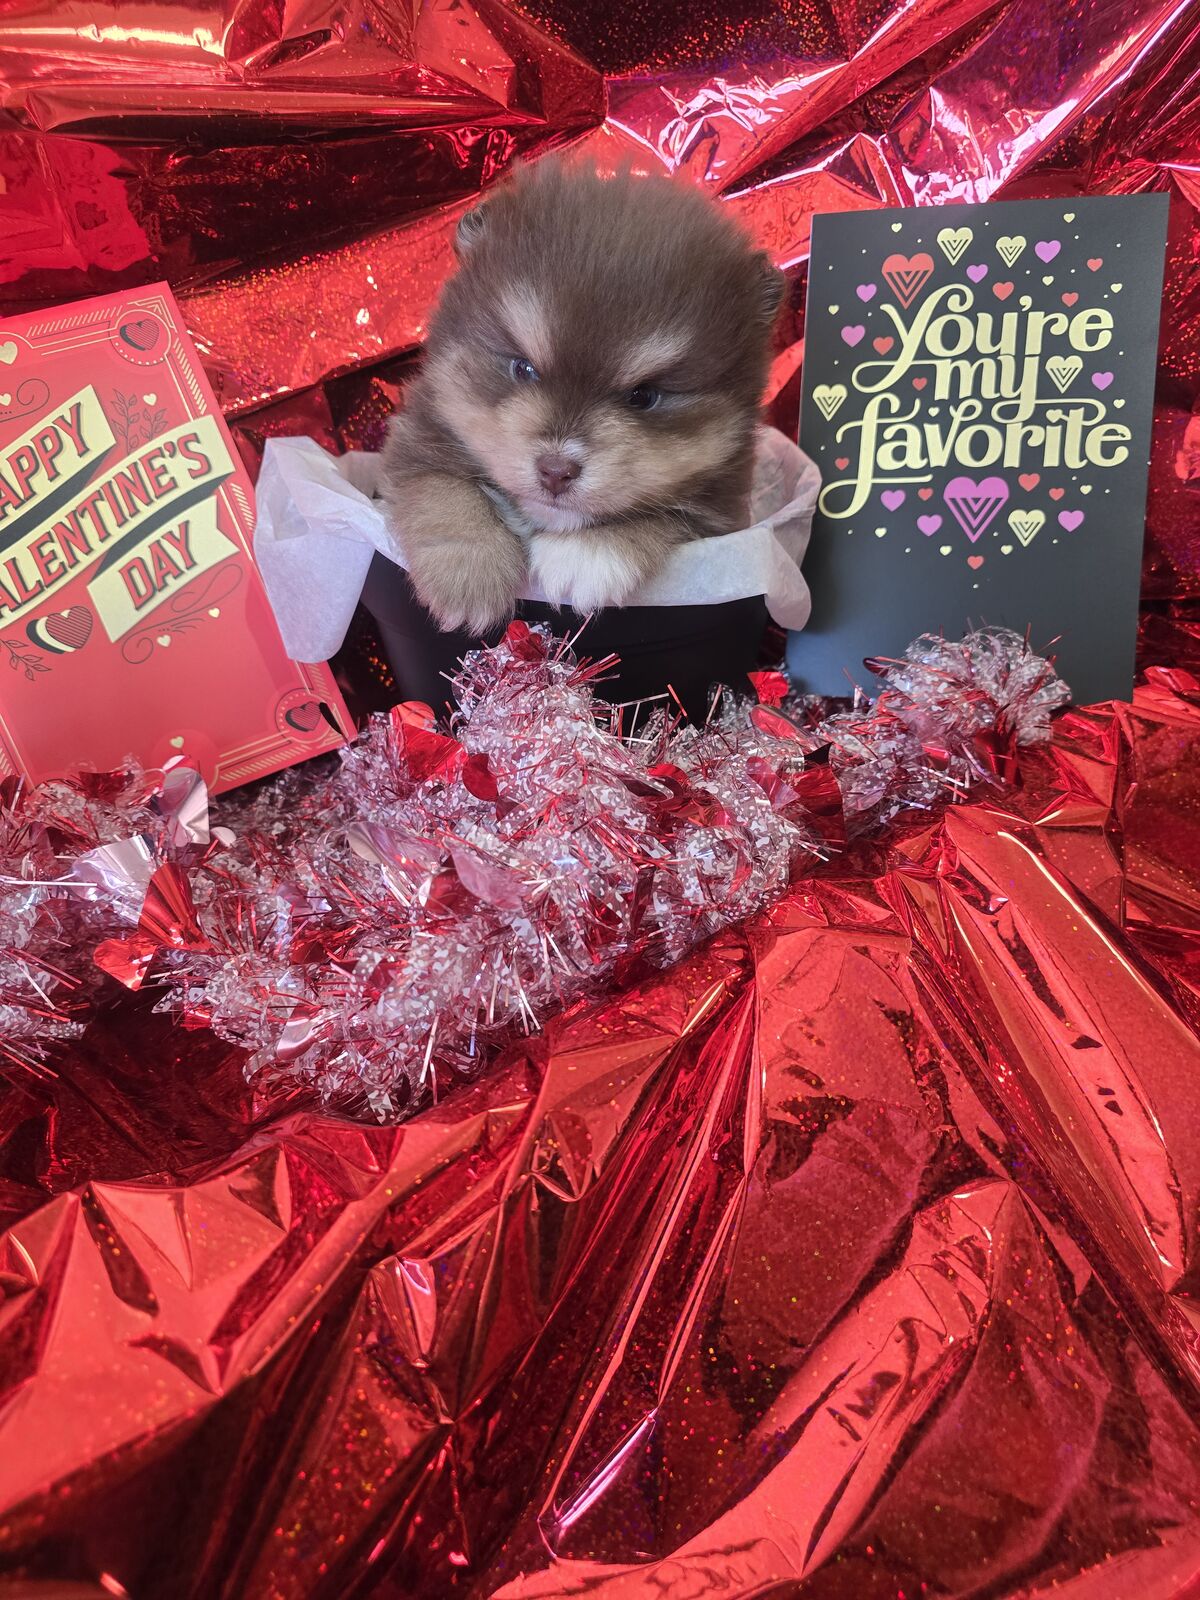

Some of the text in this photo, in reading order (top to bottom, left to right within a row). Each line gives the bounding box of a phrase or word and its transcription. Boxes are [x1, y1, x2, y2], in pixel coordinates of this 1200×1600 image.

[933, 354, 1107, 425] my
[0, 402, 90, 520] APPY
[818, 393, 1132, 519] favorite
[0, 432, 212, 618] ALENTINE'S
[118, 519, 198, 611] DAY
